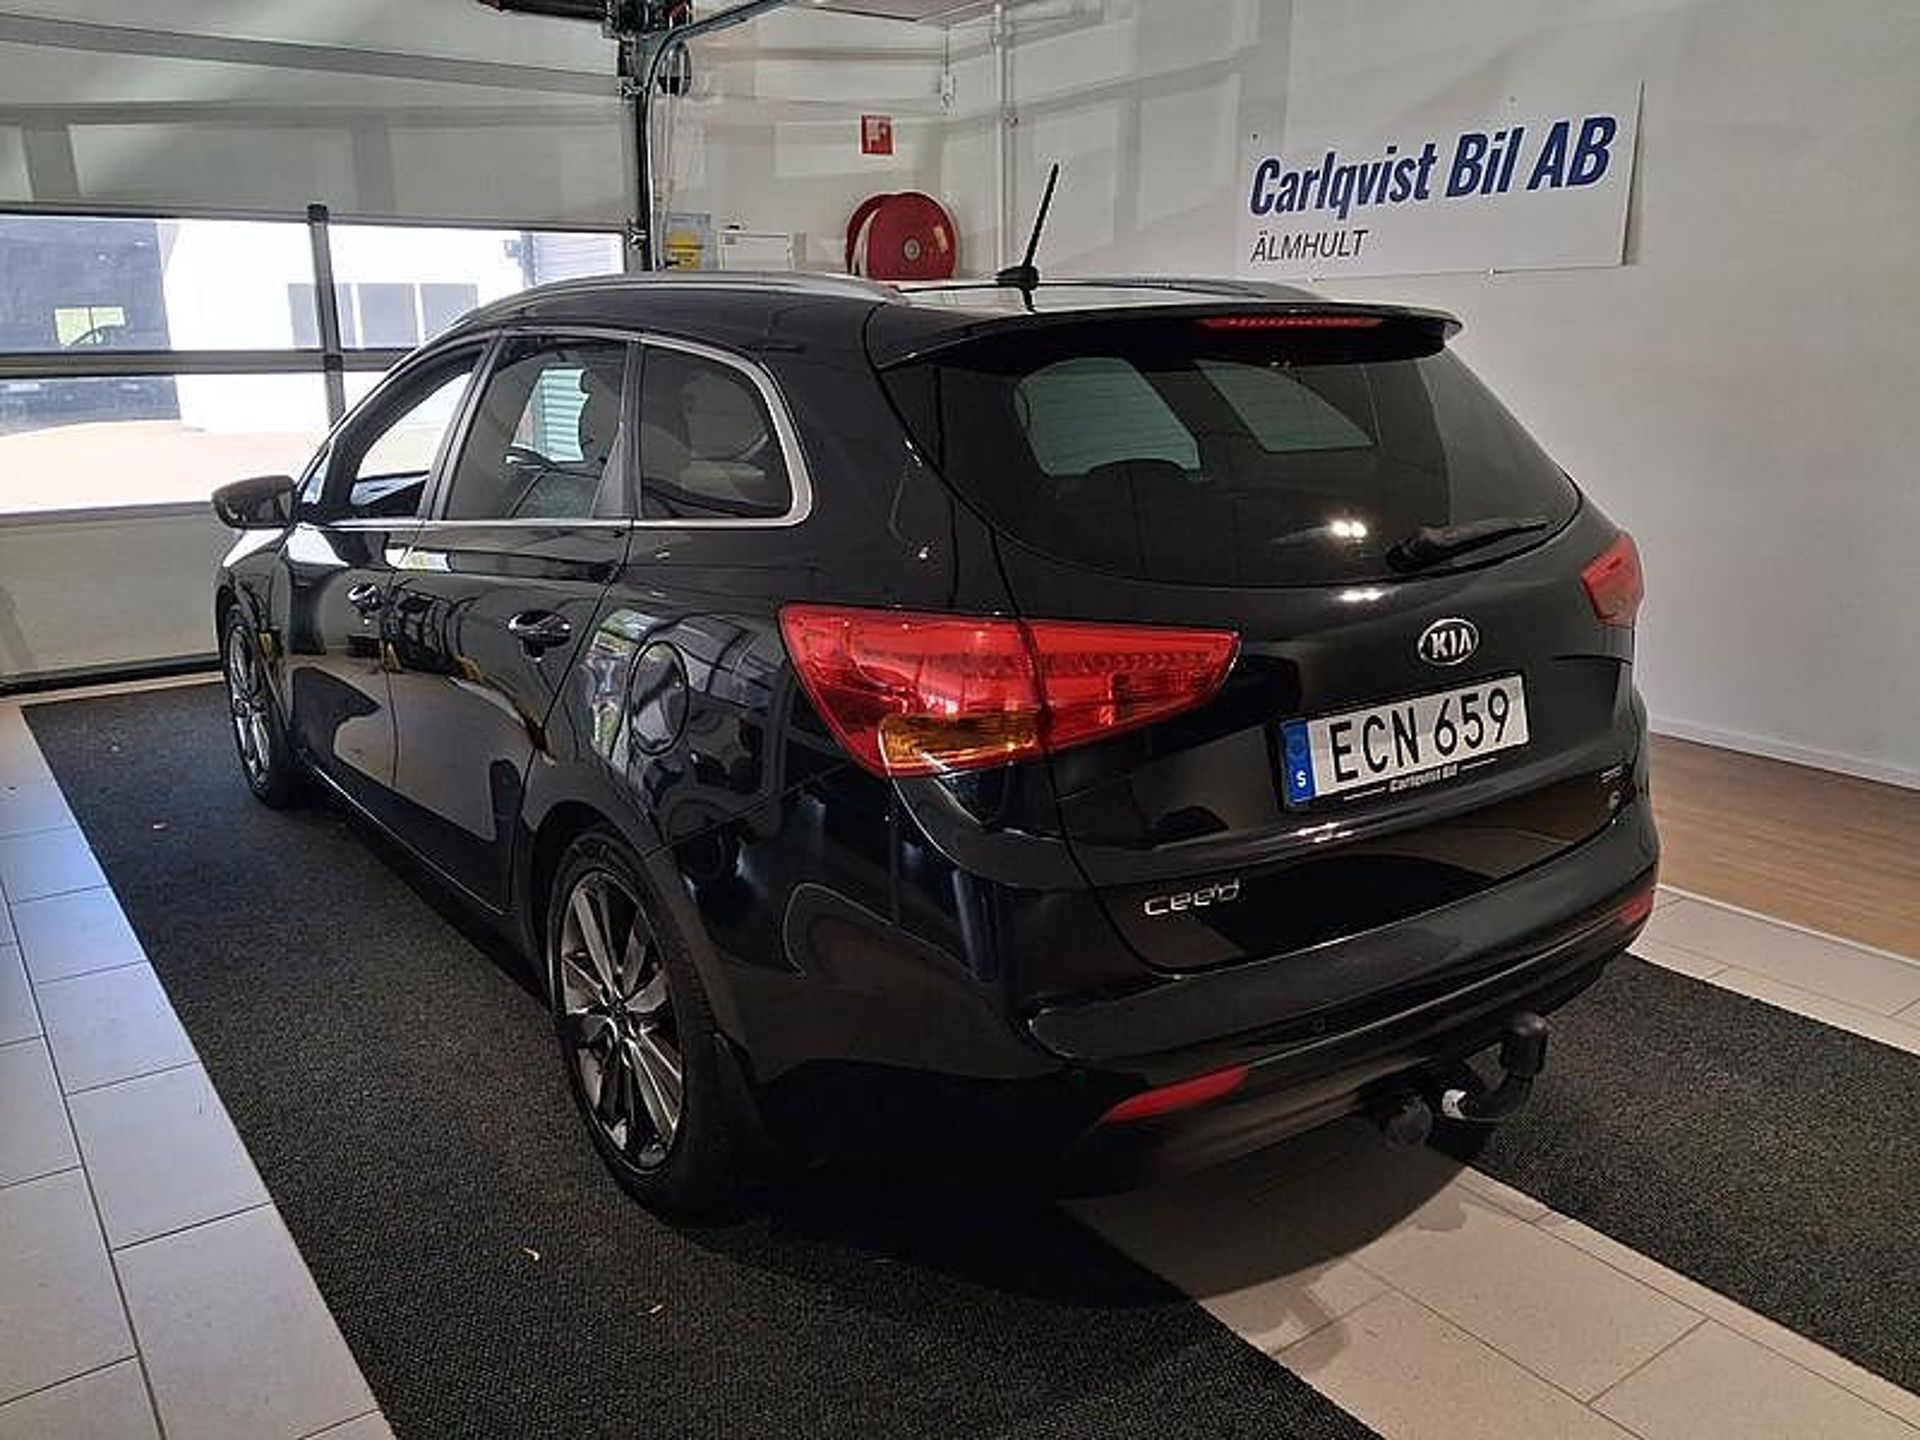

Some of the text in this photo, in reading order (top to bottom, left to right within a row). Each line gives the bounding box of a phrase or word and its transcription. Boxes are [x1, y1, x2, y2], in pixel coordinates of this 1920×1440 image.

[1250, 116, 1616, 219] Carlqvist Bil AB
[1251, 229, 1368, 262] ÄLMHULT
[1430, 628, 1472, 658] KIA
[1329, 707, 1419, 783] ECN
[1434, 688, 1509, 756] 659
[1296, 770, 1307, 788] S
